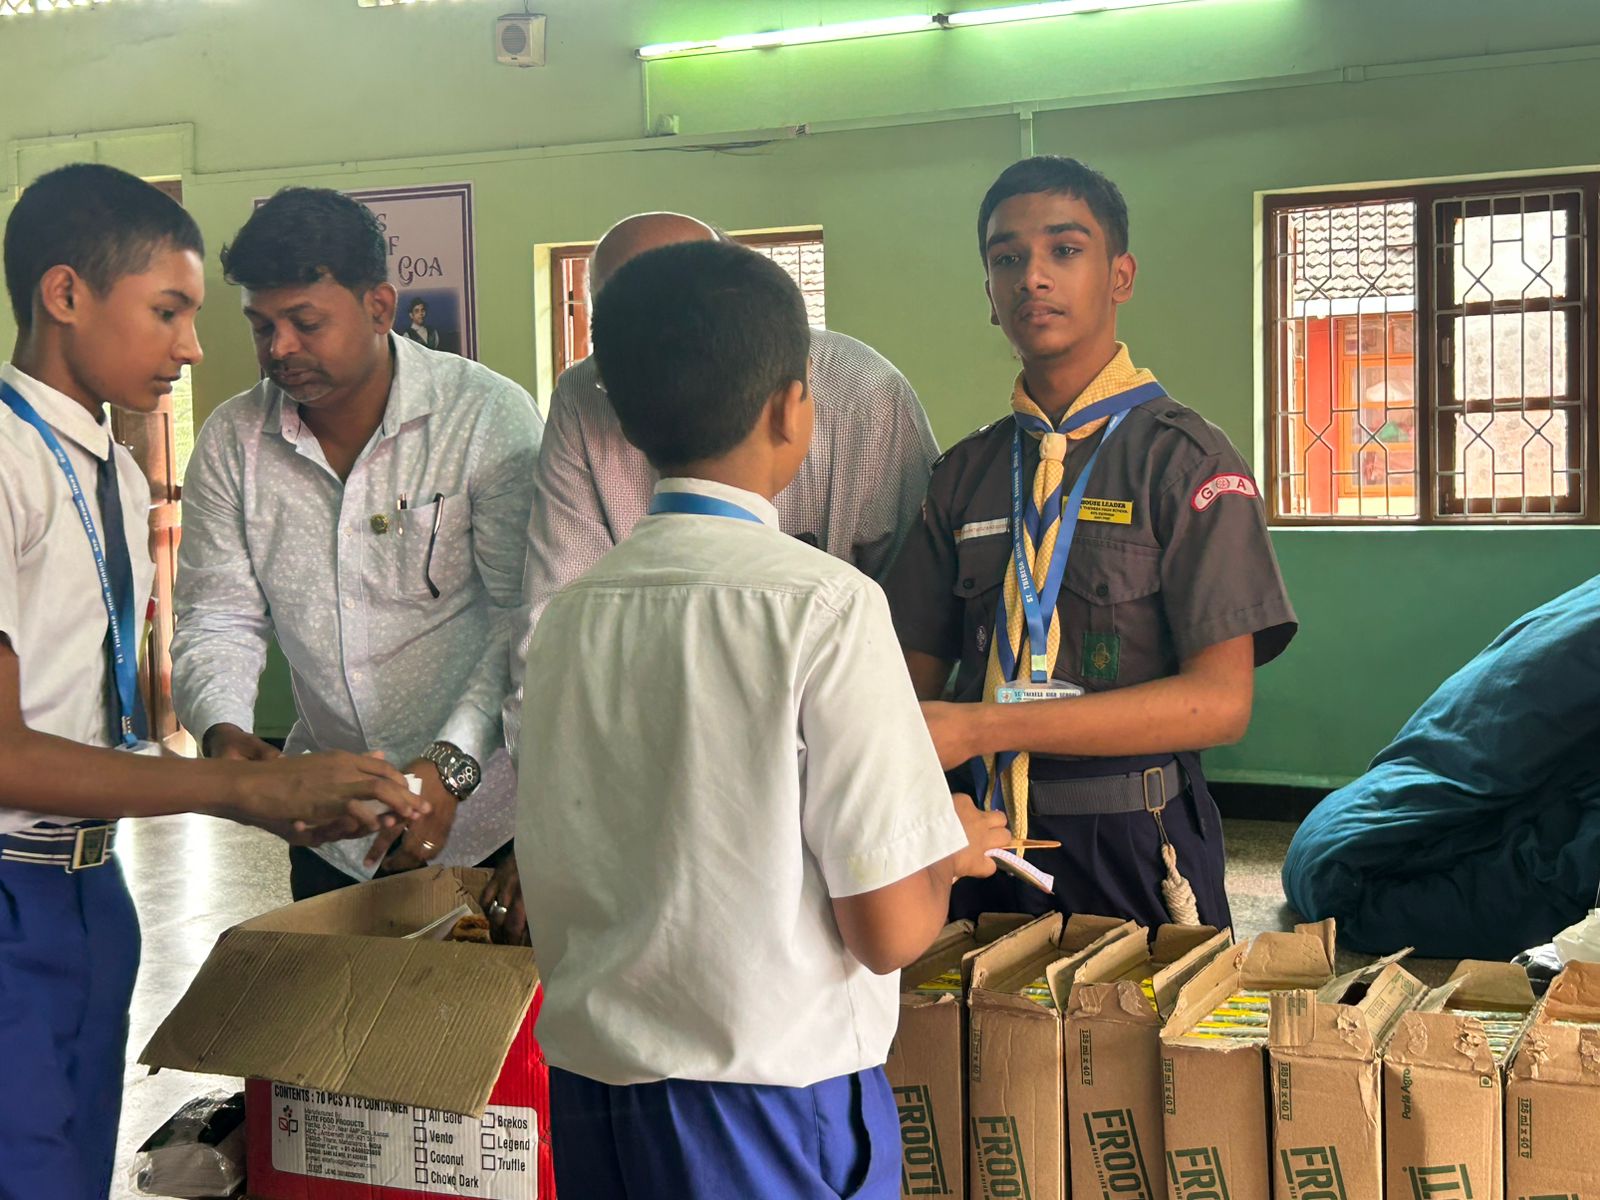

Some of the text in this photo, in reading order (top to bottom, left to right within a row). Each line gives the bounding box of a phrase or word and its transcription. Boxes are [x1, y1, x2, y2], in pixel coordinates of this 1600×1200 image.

[398, 256, 443, 286] GOA
[1201, 478, 1247, 500] GOA
[1102, 500, 1126, 508] LEADER
[1084, 1065, 1090, 1076] 40
[1400, 1068, 1413, 1094] Agro
[274, 1084, 310, 1102] CONTENTS
[316, 1091, 326, 1104] 70
[328, 1092, 343, 1106] PCS
[353, 1096, 363, 1109] 12
[1166, 1094, 1173, 1105] 40
[1282, 1100, 1290, 1111] 40
[320, 1116, 335, 1125] FOOD
[336, 1118, 364, 1128] PRODUCTS
[443, 1112, 462, 1124] Gold
[497, 1115, 528, 1129] Brekos
[430, 1130, 453, 1144] Vento
[498, 1136, 530, 1152] Legend
[1521, 1136, 1529, 1148] 40
[430, 1150, 464, 1166] Coconut
[498, 1157, 526, 1172] Truffle
[460, 1174, 479, 1188] Dark
